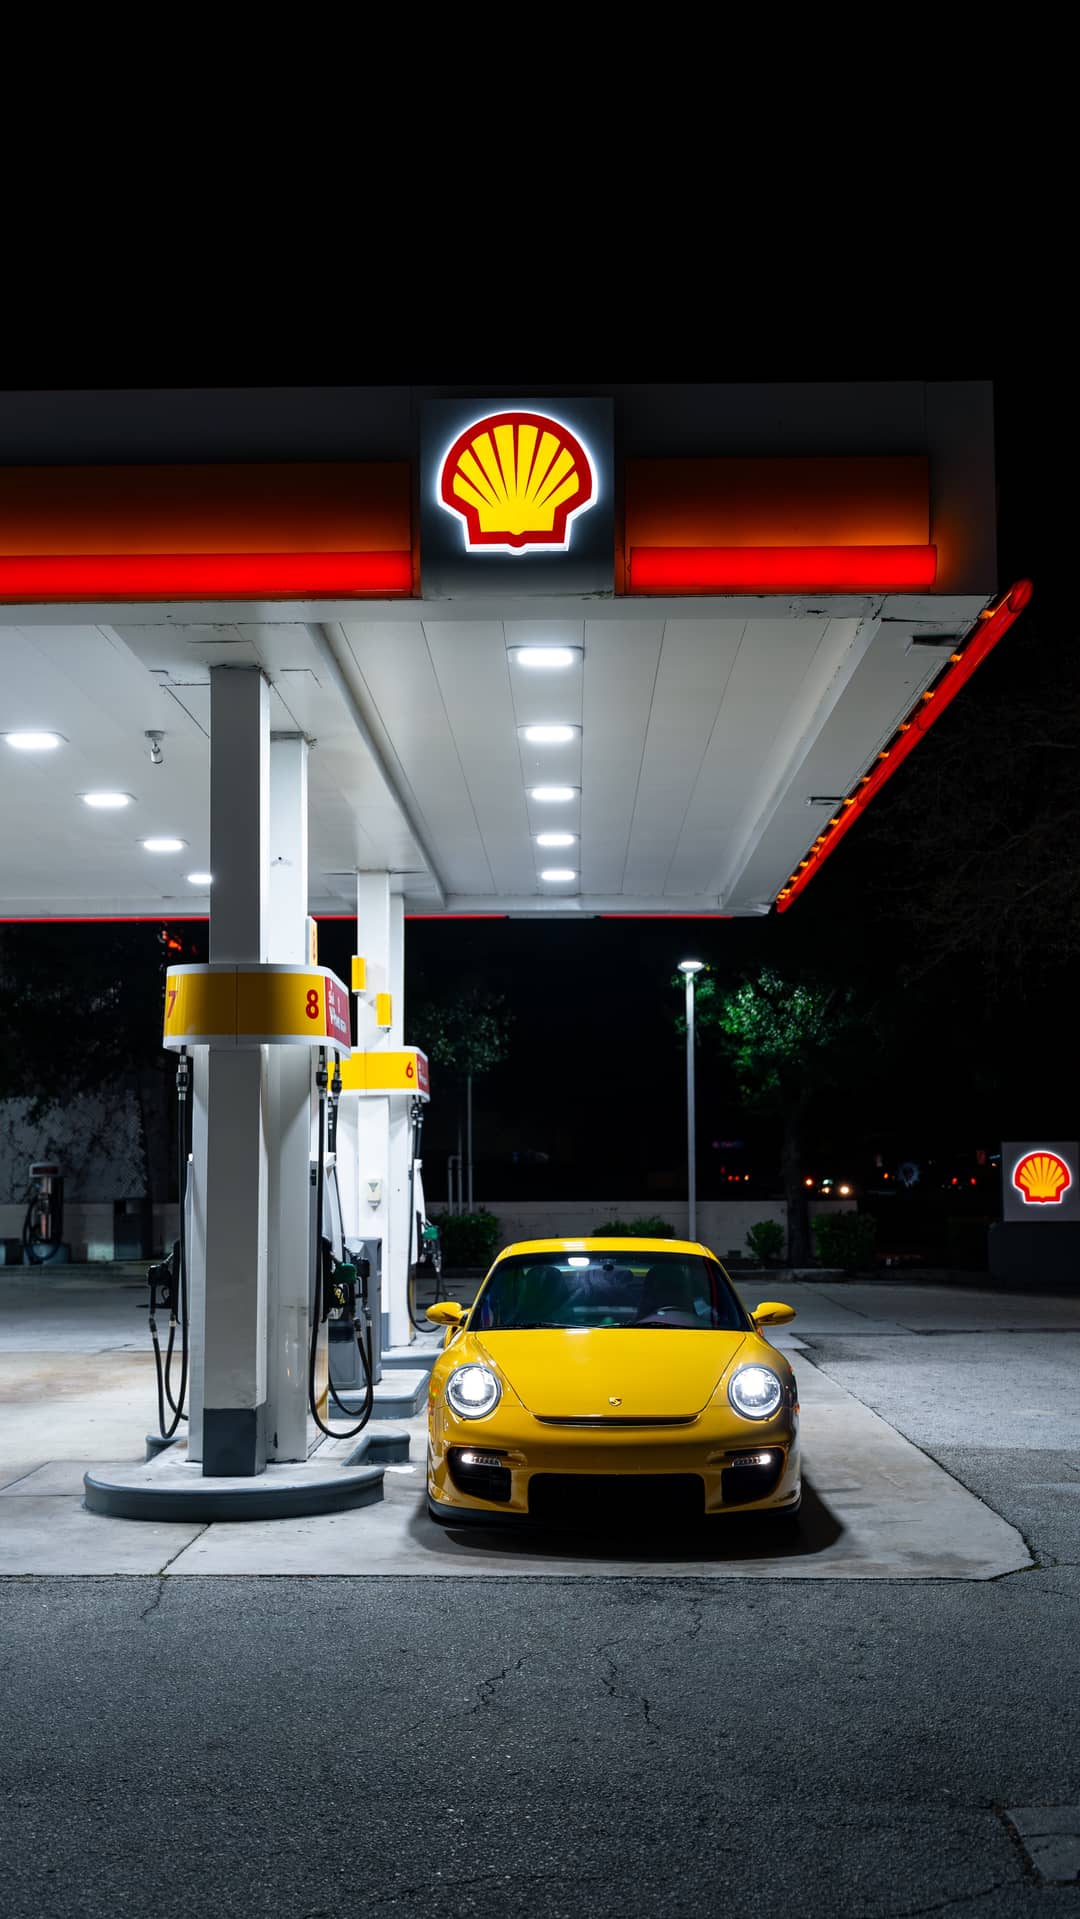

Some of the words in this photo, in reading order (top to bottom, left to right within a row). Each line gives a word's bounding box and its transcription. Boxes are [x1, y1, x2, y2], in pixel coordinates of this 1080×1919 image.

[167, 991, 177, 1018] 7
[306, 989, 319, 1019] 8
[405, 1061, 414, 1078] 6
